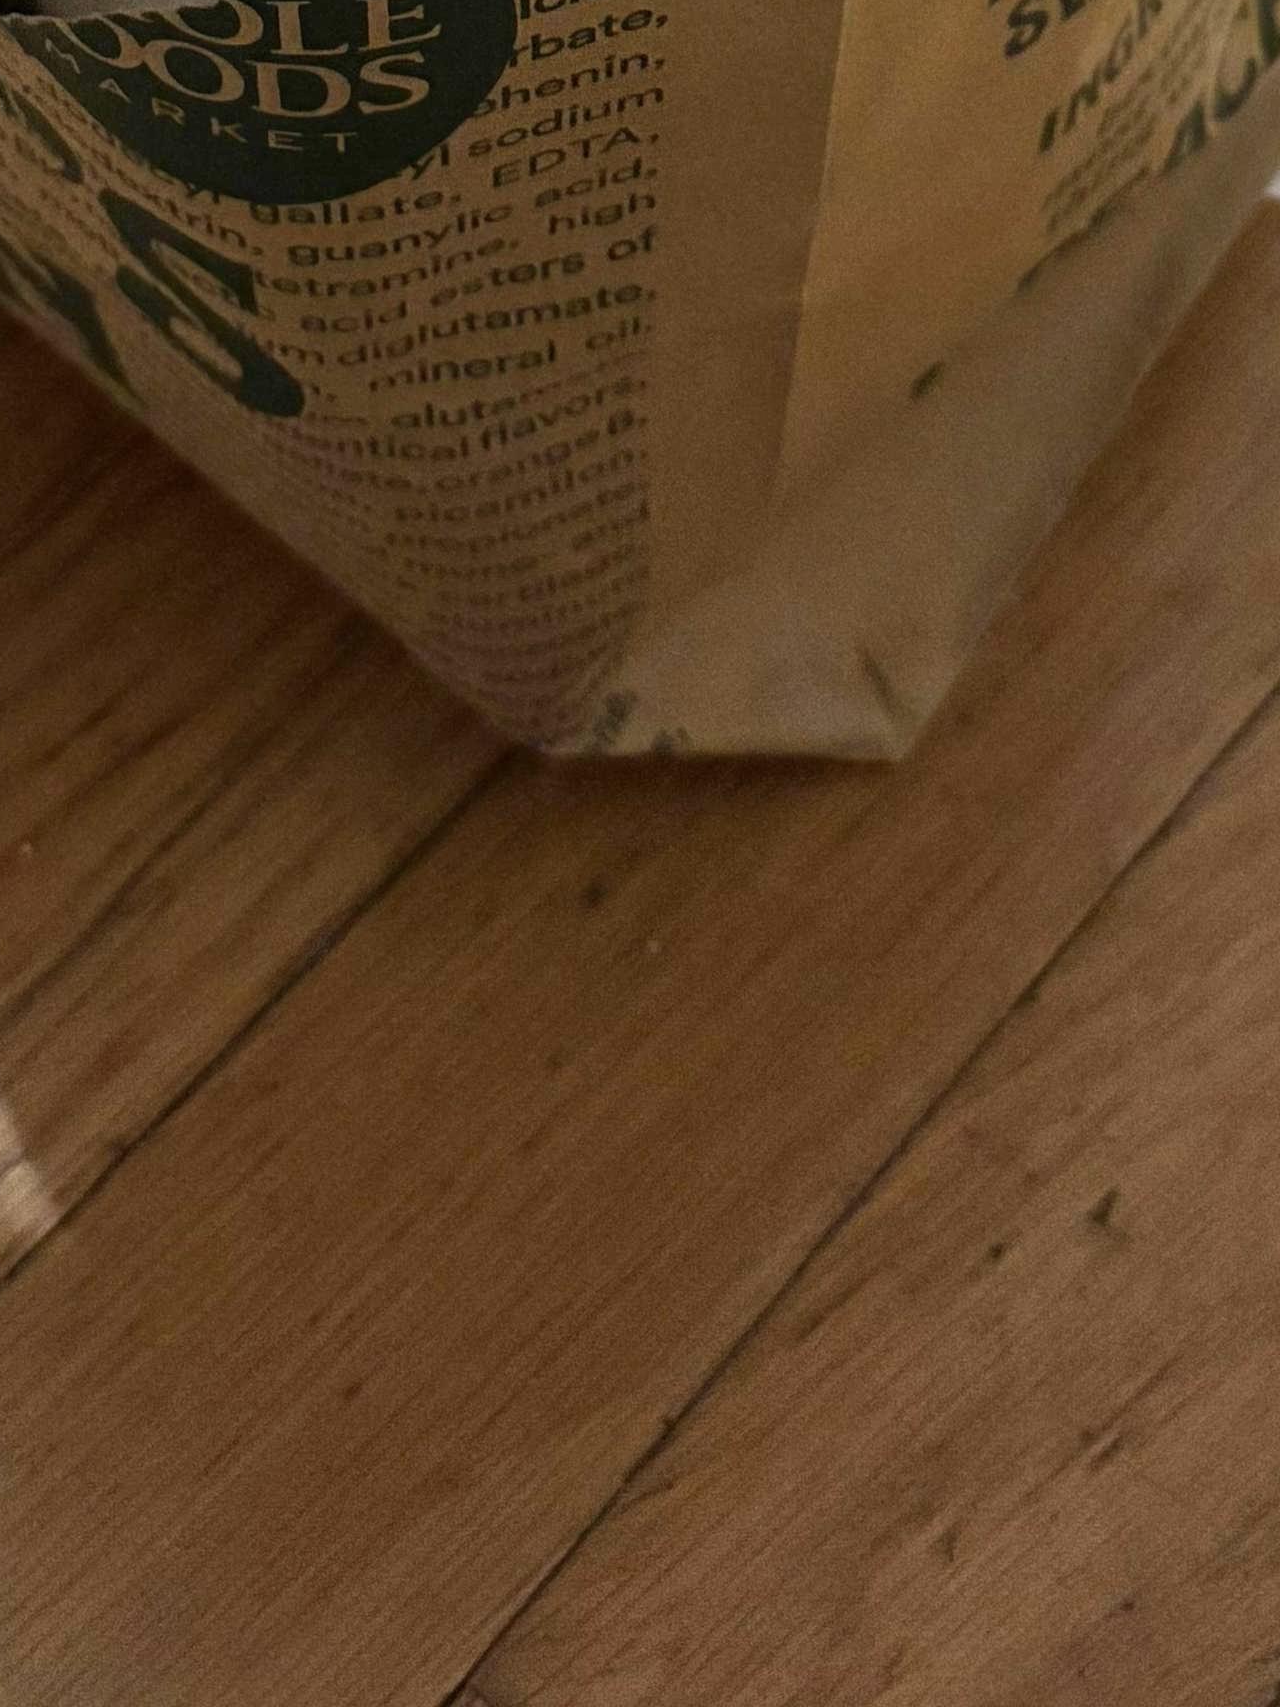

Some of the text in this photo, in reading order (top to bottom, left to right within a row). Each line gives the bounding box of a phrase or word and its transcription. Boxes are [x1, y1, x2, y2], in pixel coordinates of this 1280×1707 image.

[47, 37, 359, 155] MARKET
[469, 87, 665, 158] sodium
[493, 125, 660, 188] EDTA,
[549, 191, 658, 236] high
[606, 225, 659, 265] of
